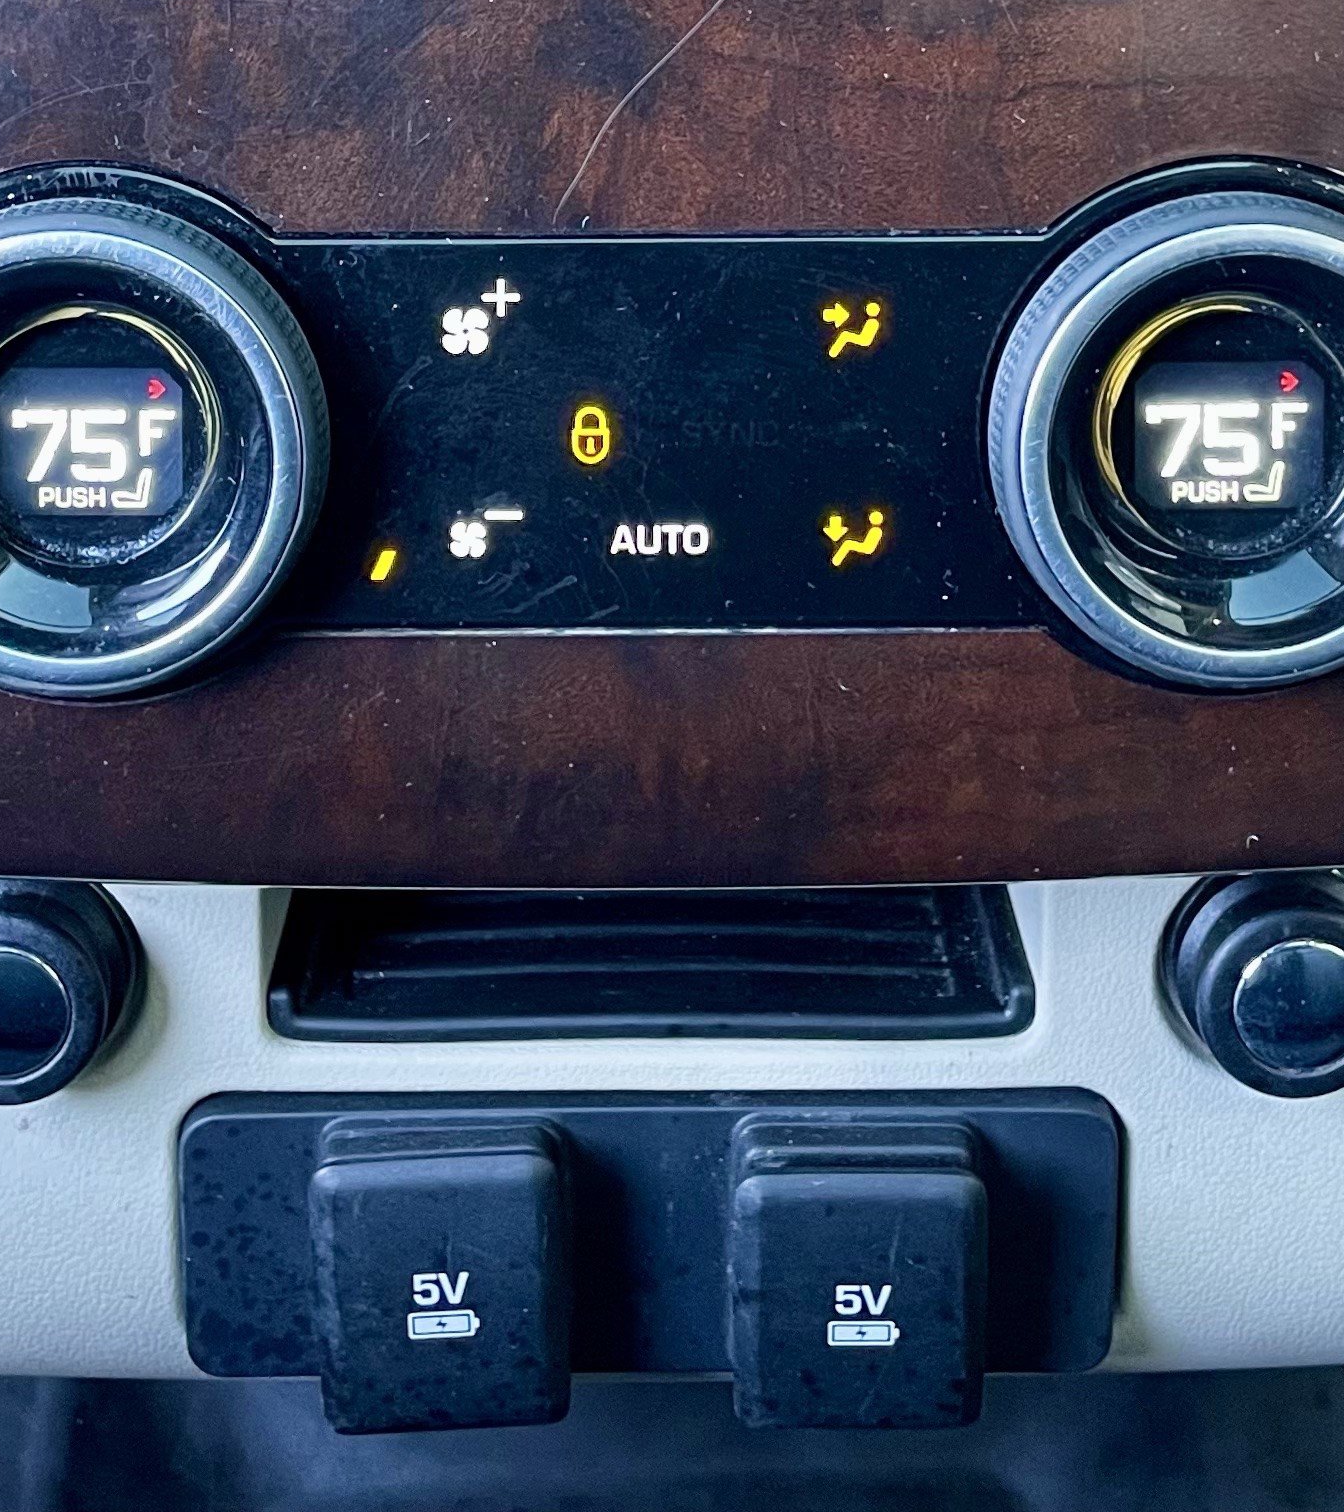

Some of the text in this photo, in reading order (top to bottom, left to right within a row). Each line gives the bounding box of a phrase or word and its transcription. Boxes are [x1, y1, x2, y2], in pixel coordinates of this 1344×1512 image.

[38, 486, 106, 509] PUSH
[1171, 480, 1239, 503] PUSH
[609, 523, 710, 556] AUTO
[412, 1271, 470, 1306] 5V
[834, 1284, 892, 1316] 5V
